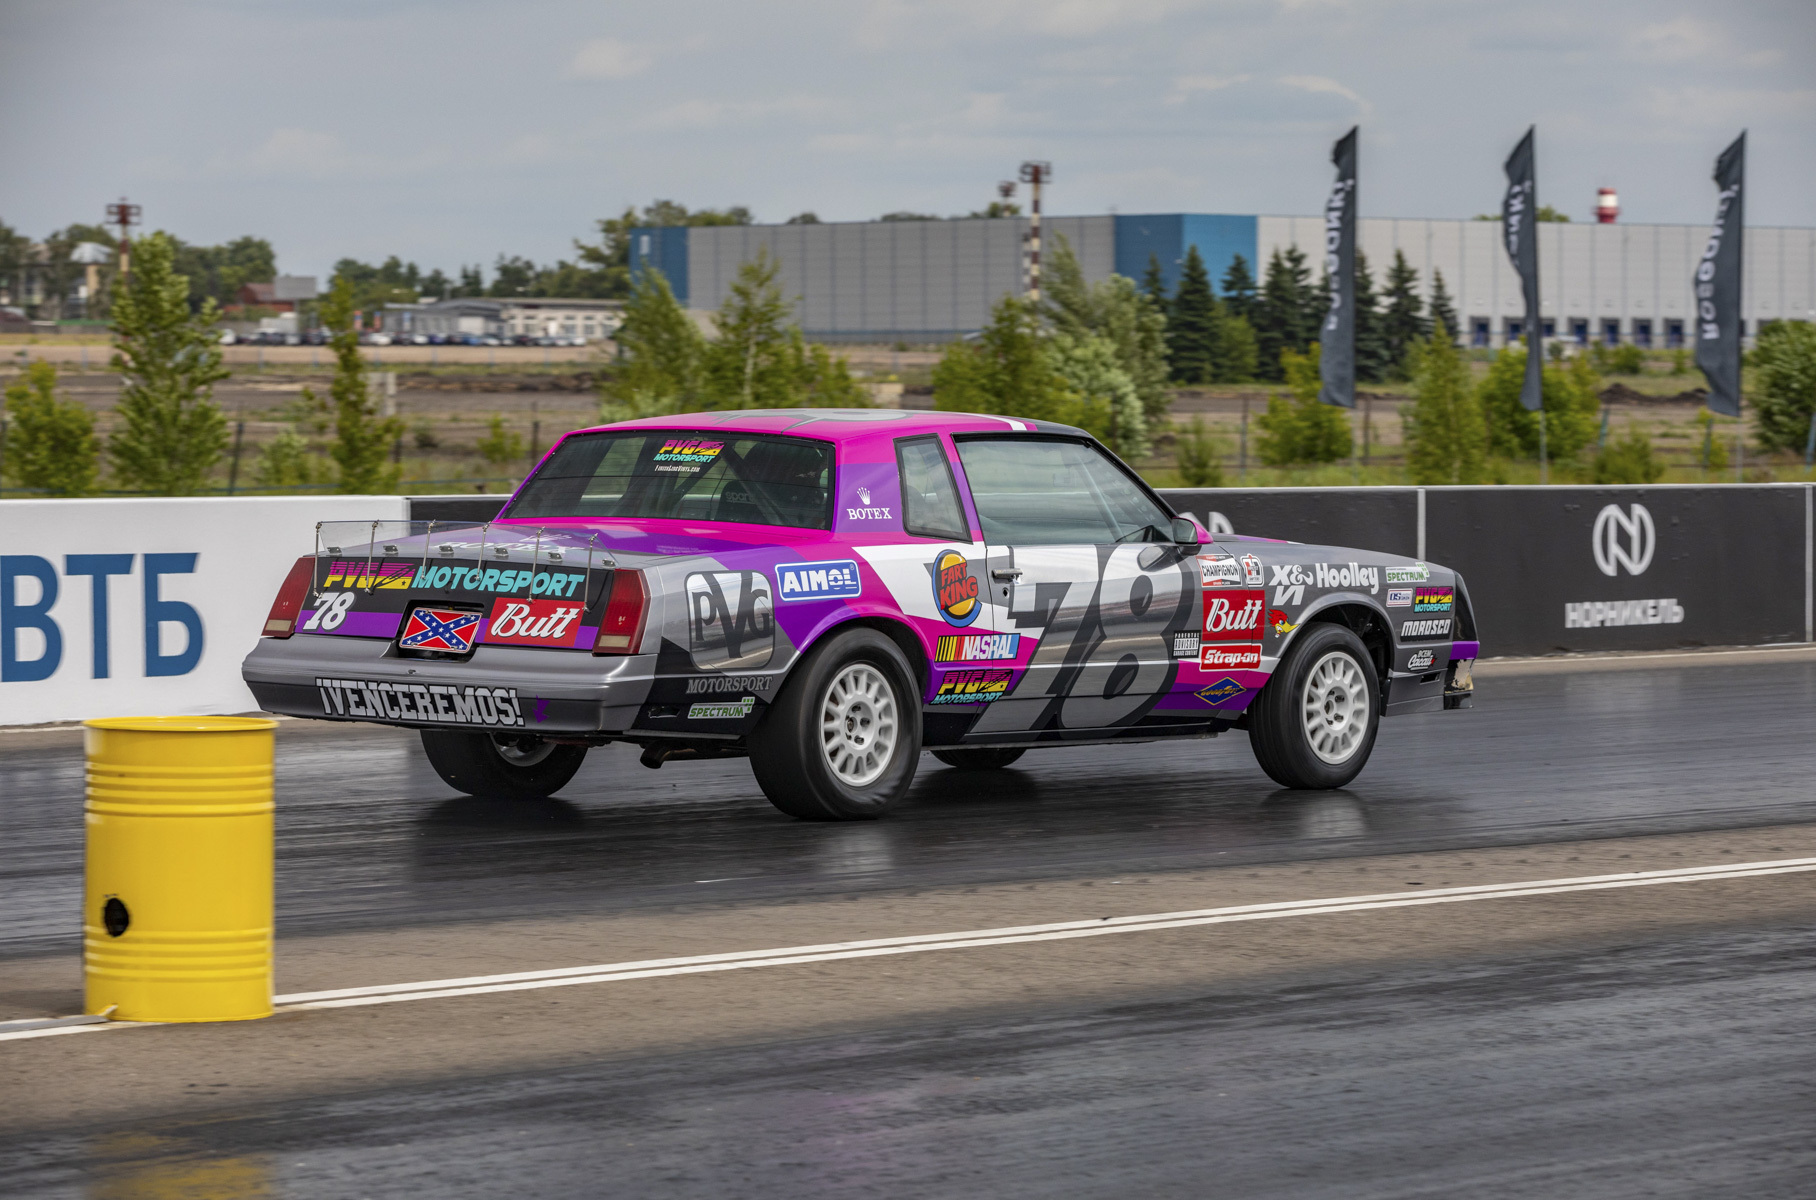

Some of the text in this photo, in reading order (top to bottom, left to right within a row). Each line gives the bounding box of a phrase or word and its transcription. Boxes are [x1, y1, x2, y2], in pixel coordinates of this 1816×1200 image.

[653, 453, 716, 463] MOTORSPORT
[846, 507, 893, 520] BOTEX
[411, 565, 585, 597] MOTORSPORT
[940, 561, 969, 584] FART
[1201, 564, 1240, 577] CHAMPIGNON
[1315, 562, 1380, 595] Hoolley
[1387, 571, 1426, 582] SPECTRUM
[940, 575, 978, 610] KING
[0, 552, 206, 683] ВТБ
[302, 591, 355, 631] 78
[491, 602, 581, 639] Butt
[691, 571, 773, 659] PVG
[1206, 598, 1263, 633] Butt
[1413, 603, 1452, 613] MOTORSPORT
[1564, 598, 1685, 629] НОРНИКЕЛЬ
[966, 543, 1195, 736] 78
[1401, 619, 1452, 637] MOROSCO
[961, 634, 1015, 661] NASRAL
[1174, 638, 1199, 650] ADVISORY
[1203, 649, 1259, 667] Strap-on
[686, 676, 773, 694] MOTORSPORT
[315, 677, 525, 727] ¡VENCEREMOS!
[930, 691, 1004, 705] MOTORSPORT
[689, 706, 745, 718] SPECTRUM
